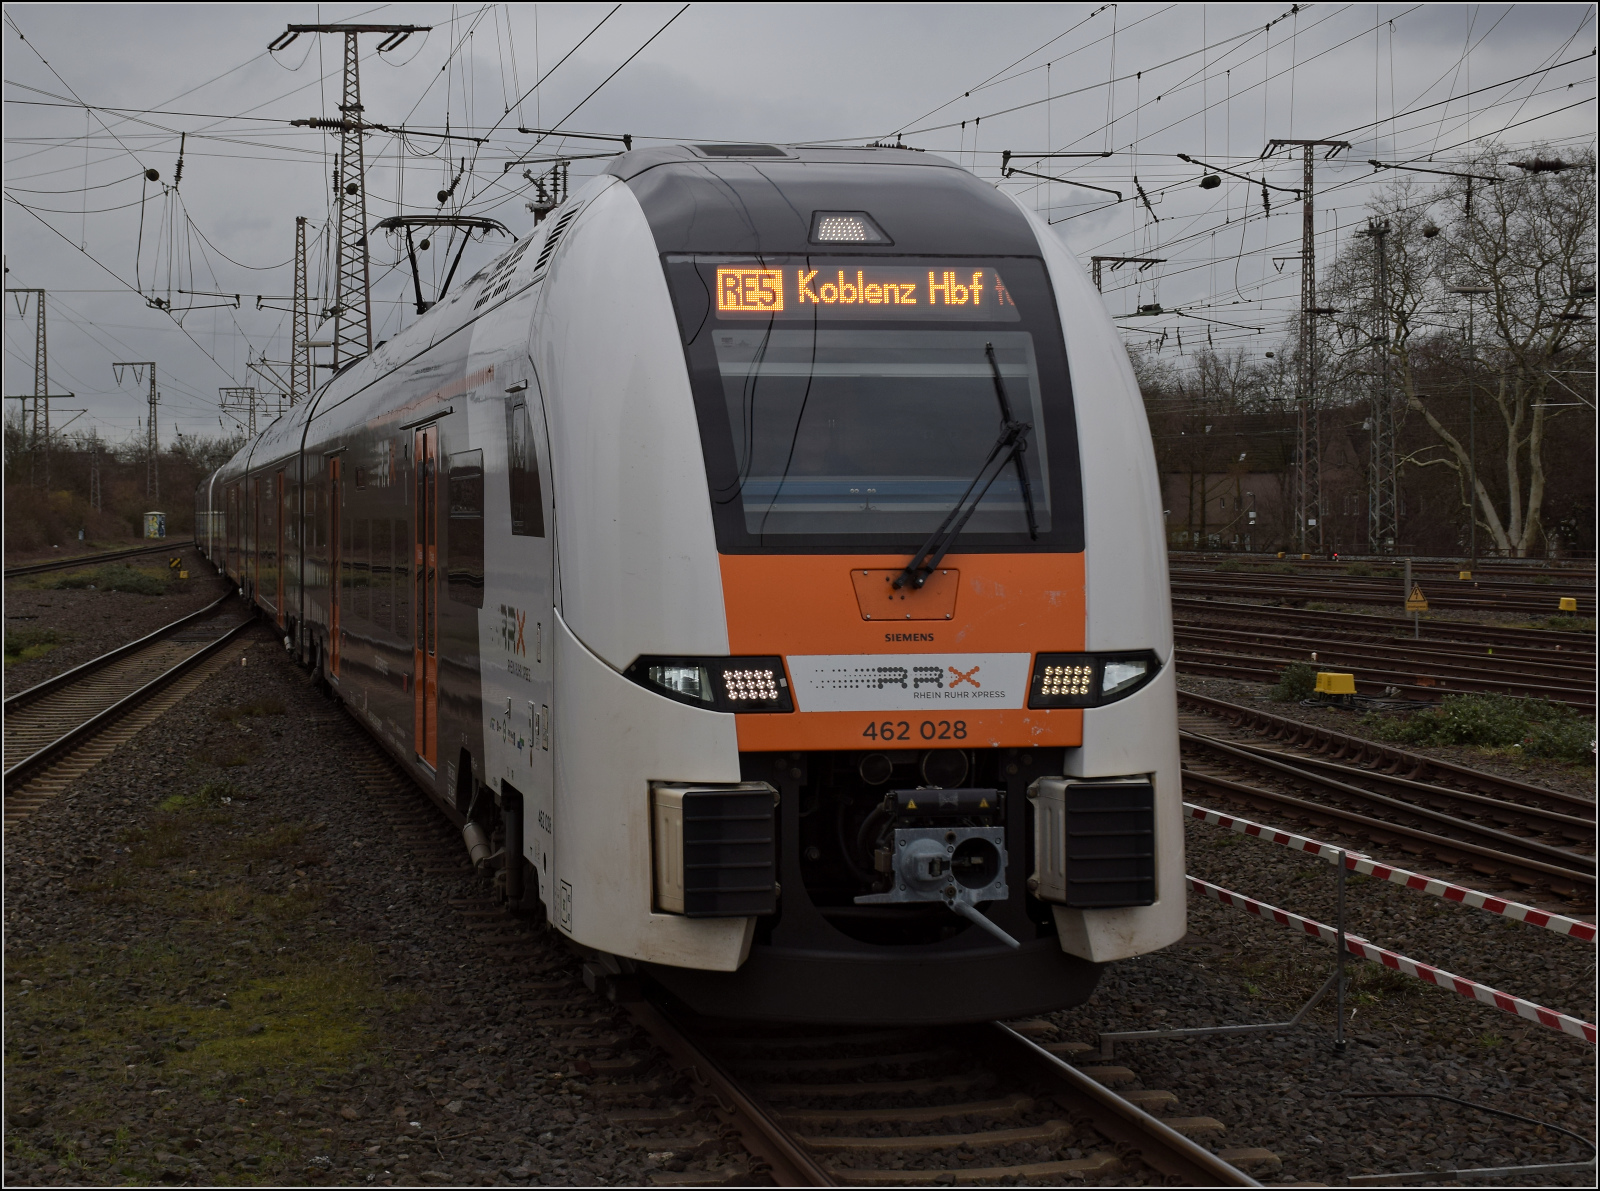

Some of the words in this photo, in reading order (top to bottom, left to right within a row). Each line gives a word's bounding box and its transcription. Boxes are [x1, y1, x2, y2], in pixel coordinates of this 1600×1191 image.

[720, 271, 780, 309] RE5
[797, 269, 917, 305] Koblenz
[928, 270, 983, 306] Hbf
[884, 632, 935, 643] SIEMENS
[876, 665, 982, 690] RRX
[913, 691, 942, 699] RHEIN
[944, 691, 970, 699] RUHR
[971, 690, 1006, 699] XPRESS
[862, 721, 911, 741] 462
[919, 720, 968, 741] 028
